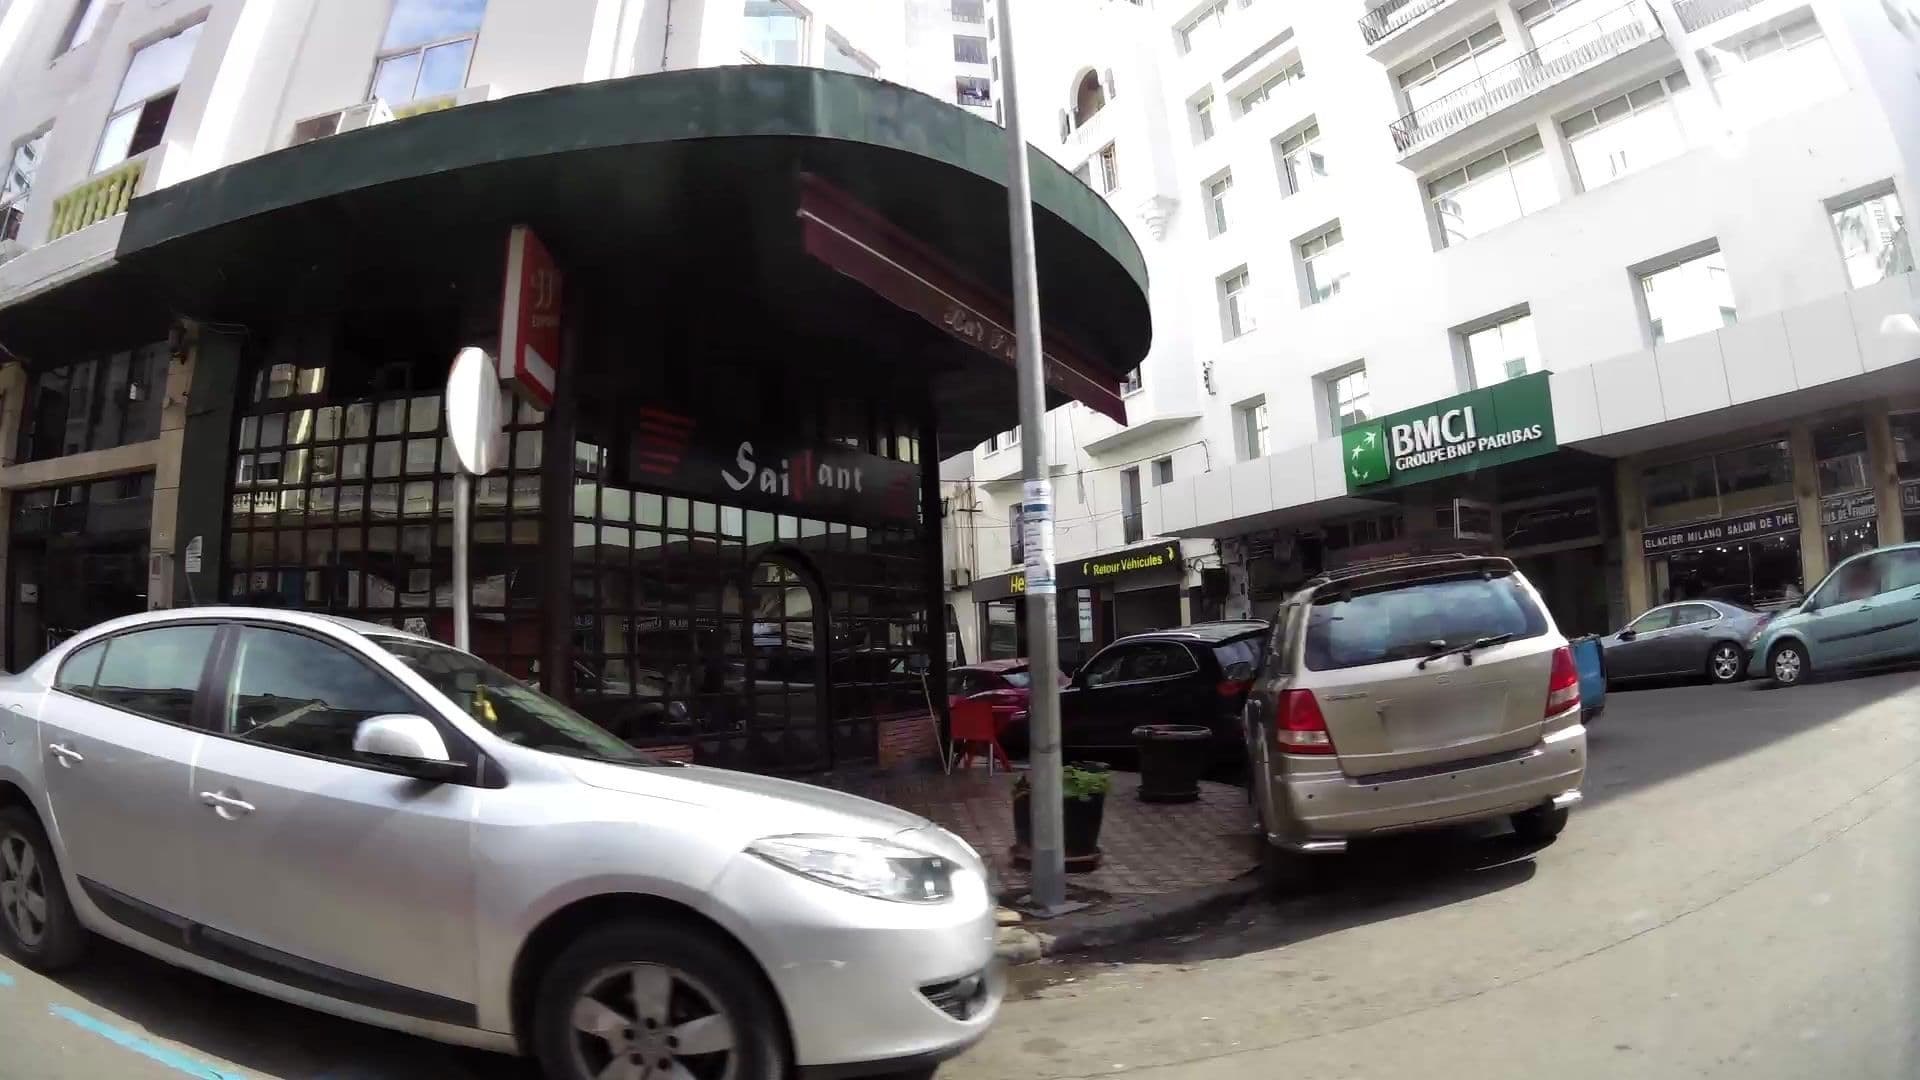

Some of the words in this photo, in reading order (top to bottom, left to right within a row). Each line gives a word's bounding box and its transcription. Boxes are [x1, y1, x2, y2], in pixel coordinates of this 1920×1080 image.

[1391, 405, 1476, 457] BMCI
[1395, 447, 1448, 471] GROUPE
[1447, 440, 1477, 460] BNP
[1478, 424, 1543, 451] PARIBAS
[721, 441, 863, 502] Saillant
[1645, 534, 1684, 549] GLACIER
[1687, 527, 1722, 542] MILANO
[1727, 521, 1757, 535] SALON
[1759, 517, 1773, 529] DE
[1775, 512, 1795, 526] THE
[1093, 561, 1121, 577] Retour
[1121, 554, 1163, 571] Véhicules
